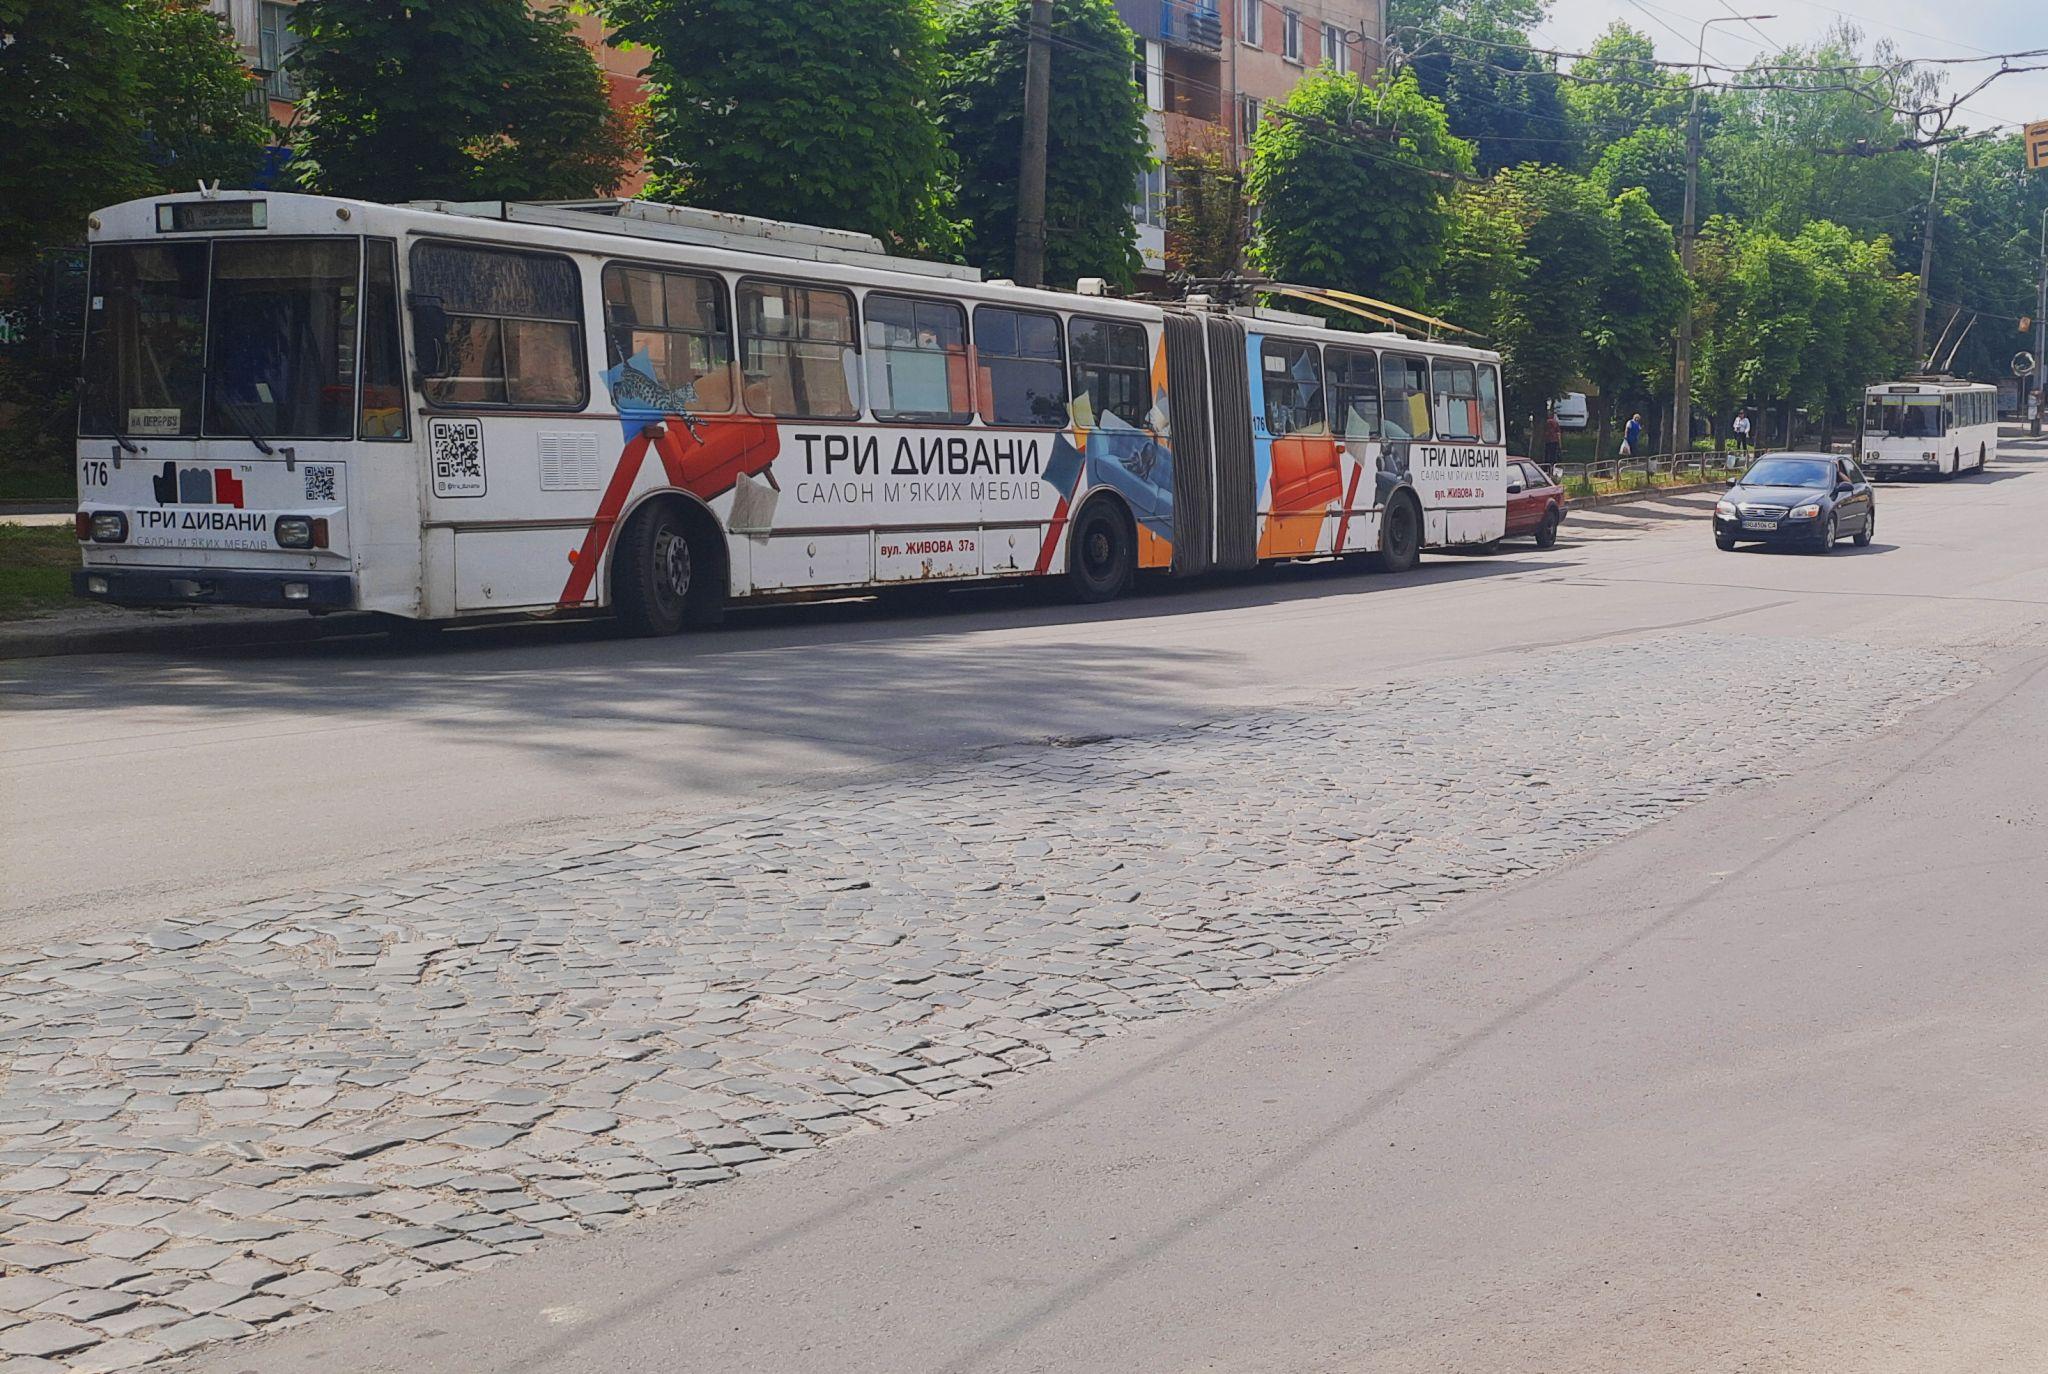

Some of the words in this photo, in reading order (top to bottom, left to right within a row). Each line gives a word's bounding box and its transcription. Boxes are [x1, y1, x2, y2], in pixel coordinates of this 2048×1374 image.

[1253, 416, 1266, 432] 176
[794, 434, 879, 475] ТРИ
[891, 436, 1039, 475] ДИВАНИ
[1420, 447, 1447, 467] ТРИ
[1450, 448, 1499, 468] ДИВАНИ
[83, 461, 108, 487] 176
[796, 482, 874, 504] САЛОН
[884, 482, 962, 502] М'ЯКИХ
[971, 481, 1040, 501] МЕБЛІВ
[136, 510, 176, 528] ТРИ
[181, 511, 267, 532] ДИВАНИ
[136, 537, 173, 547] САЛОН
[224, 539, 268, 550] МЕБЛІВ
[880, 545, 902, 558] вул.
[905, 540, 954, 555] ЖИВОВА
[958, 539, 975, 552] 37а
